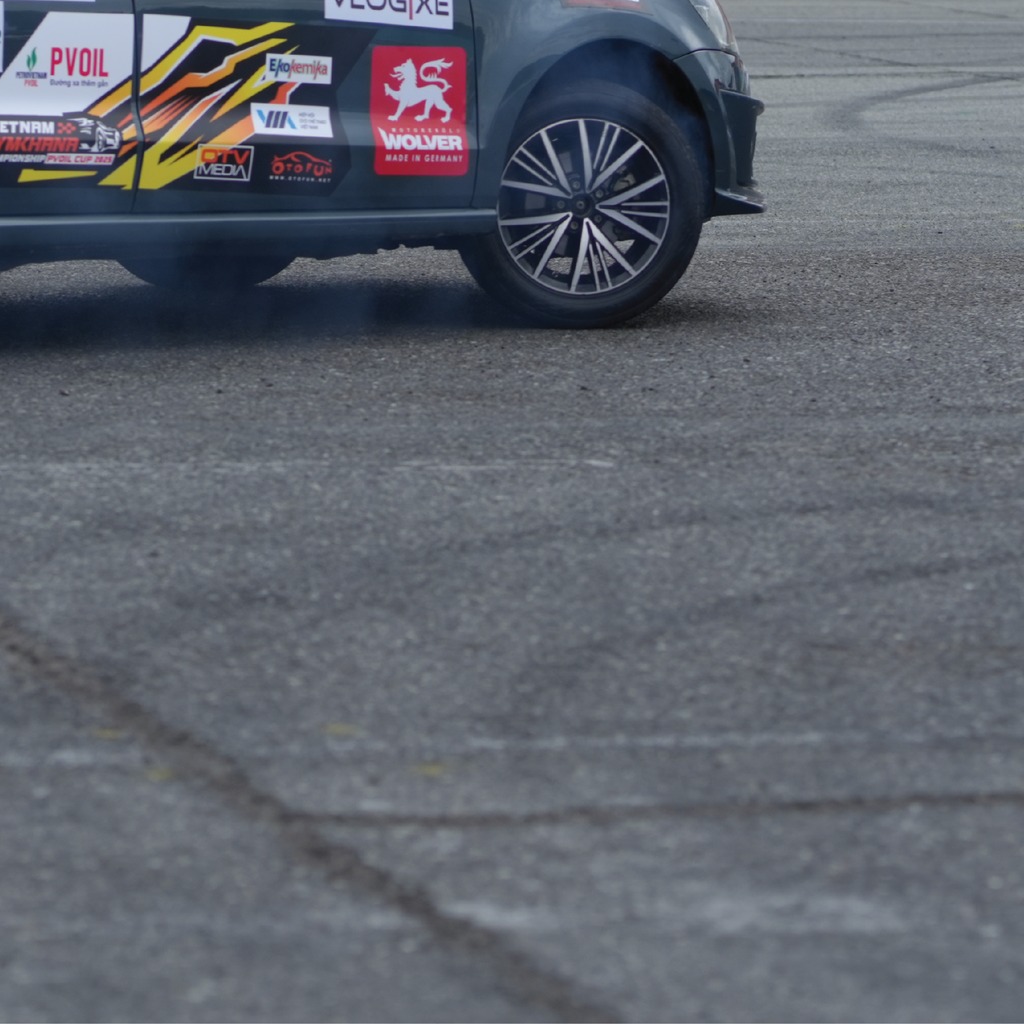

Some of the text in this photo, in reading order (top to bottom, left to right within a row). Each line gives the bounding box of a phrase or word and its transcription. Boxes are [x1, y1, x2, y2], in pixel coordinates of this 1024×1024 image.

[50, 47, 109, 77] PVOIL
[269, 58, 328, 80] Ekokemika
[378, 127, 463, 151] WOLVER
[385, 154, 463, 163] MADE IN GERMANY
